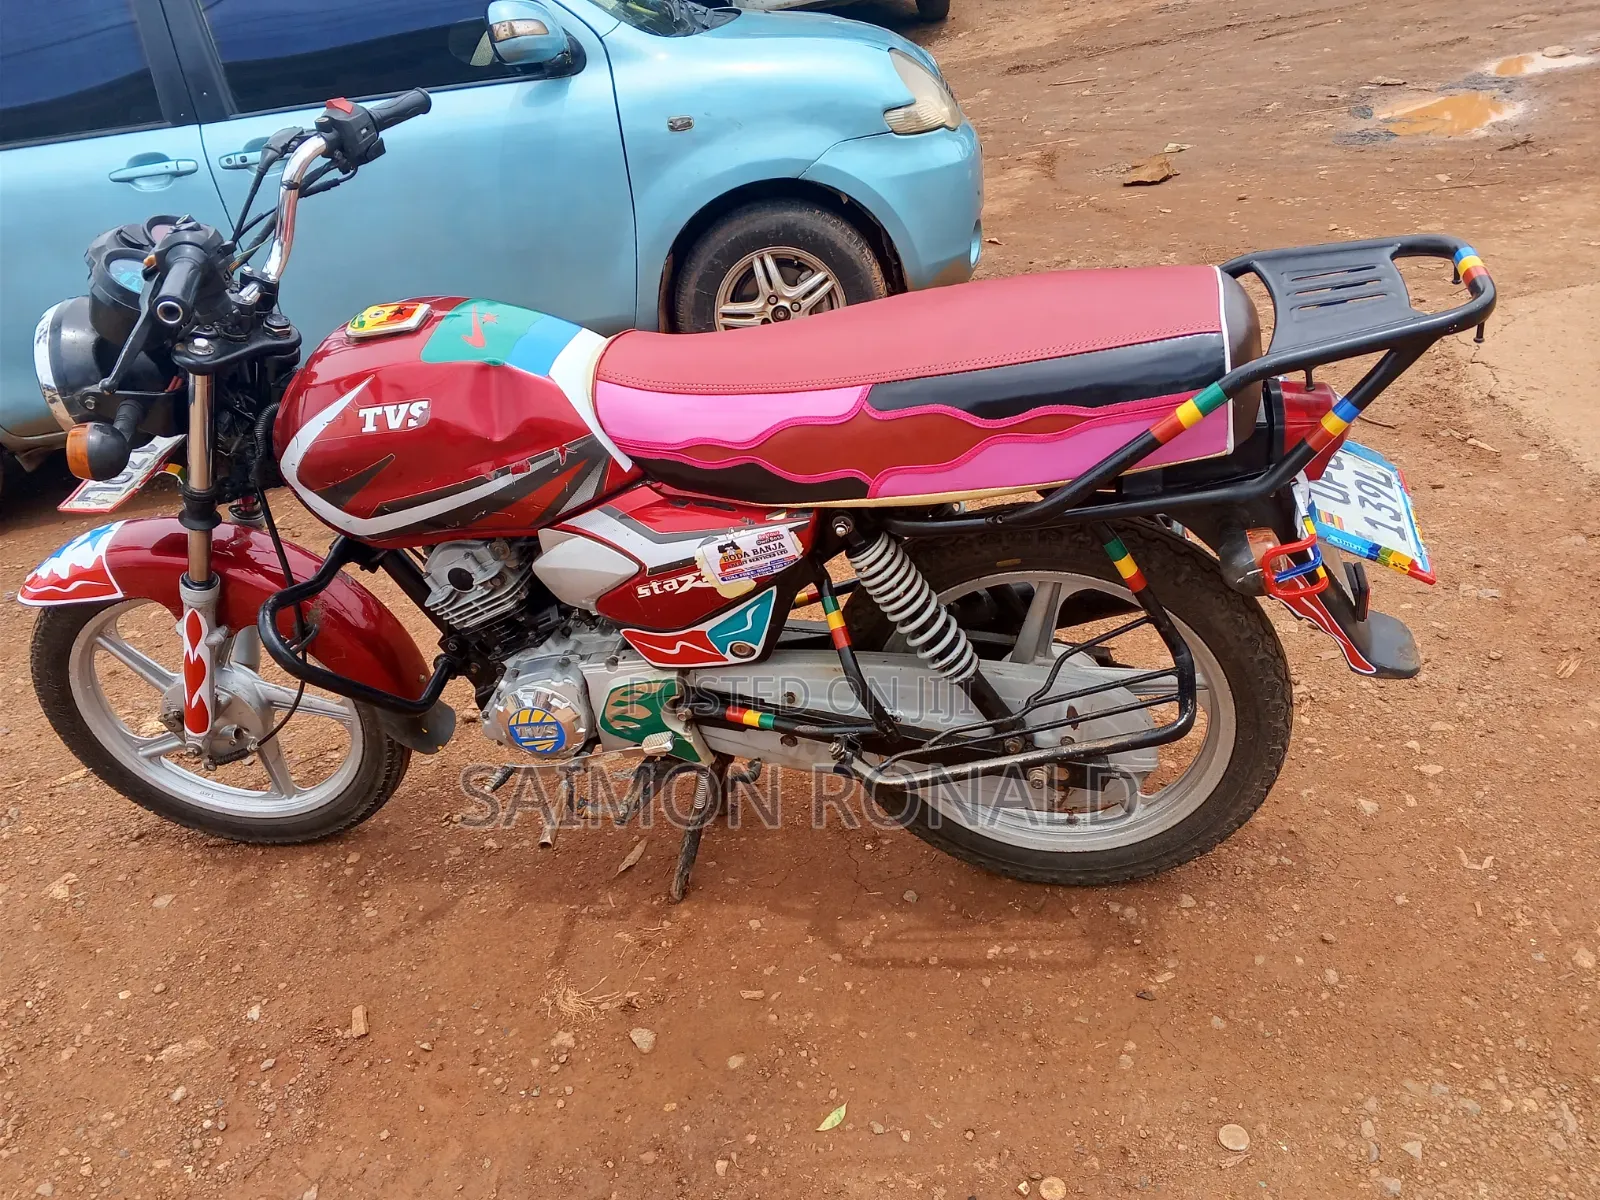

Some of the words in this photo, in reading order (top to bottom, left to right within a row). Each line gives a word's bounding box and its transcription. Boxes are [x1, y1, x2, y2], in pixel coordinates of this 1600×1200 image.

[358, 400, 429, 433] TVS
[1353, 469, 1407, 541] 139L
[723, 551, 750, 562] BODA
[752, 542, 785, 556] BANJA
[749, 552, 775, 563] SERVICES
[514, 723, 558, 738] TVS
